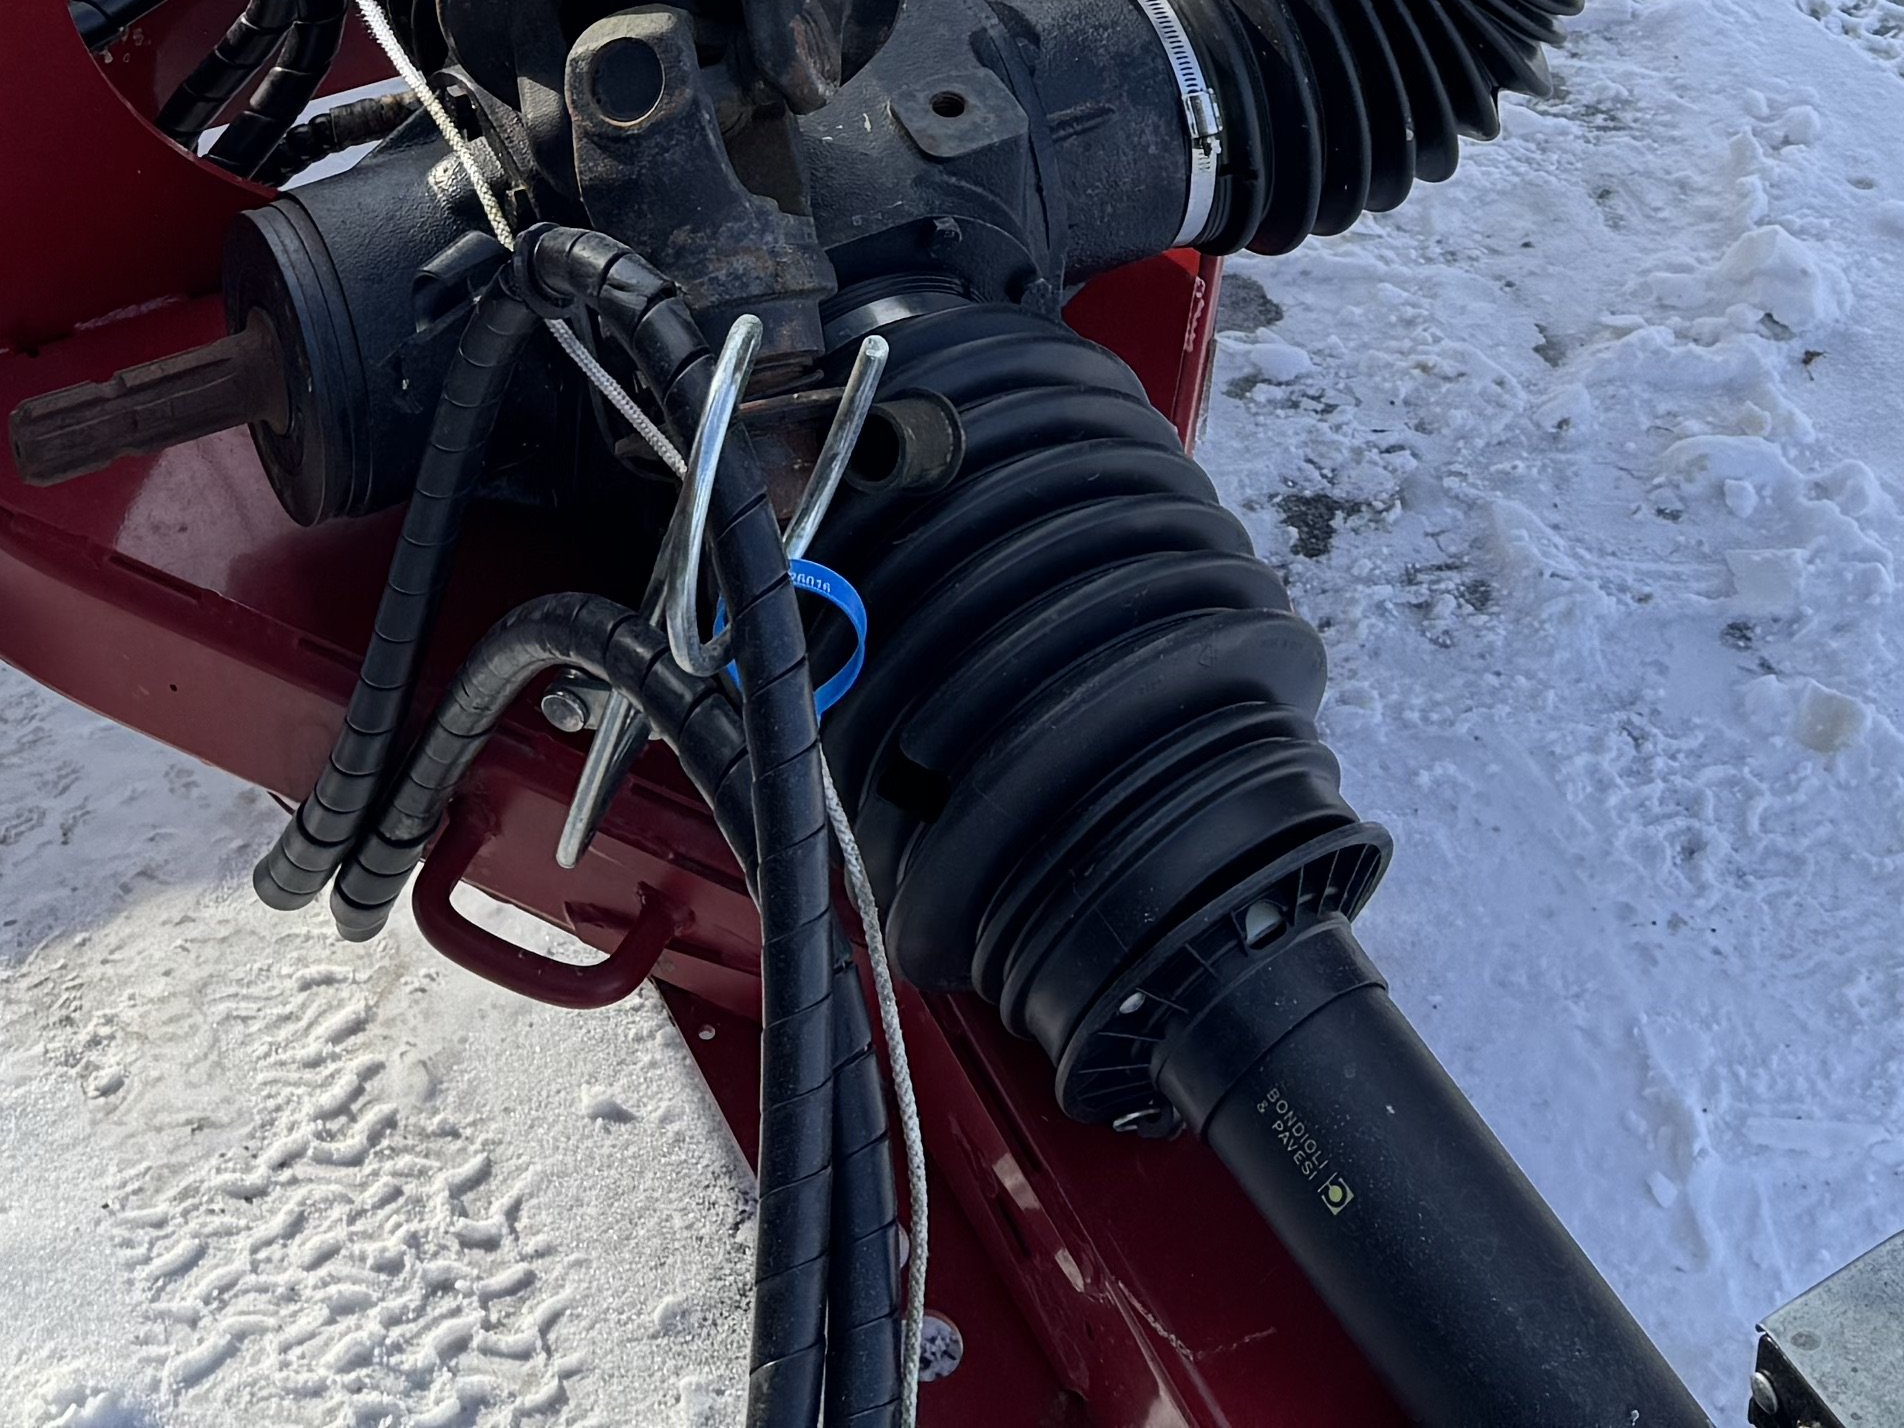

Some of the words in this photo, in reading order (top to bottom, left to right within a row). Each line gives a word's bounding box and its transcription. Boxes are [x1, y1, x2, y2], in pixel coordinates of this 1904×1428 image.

[1257, 1100, 1268, 1113] &
[1271, 1119, 1317, 1182] PAVESI
[1265, 1087, 1330, 1170] BONDIOLI
